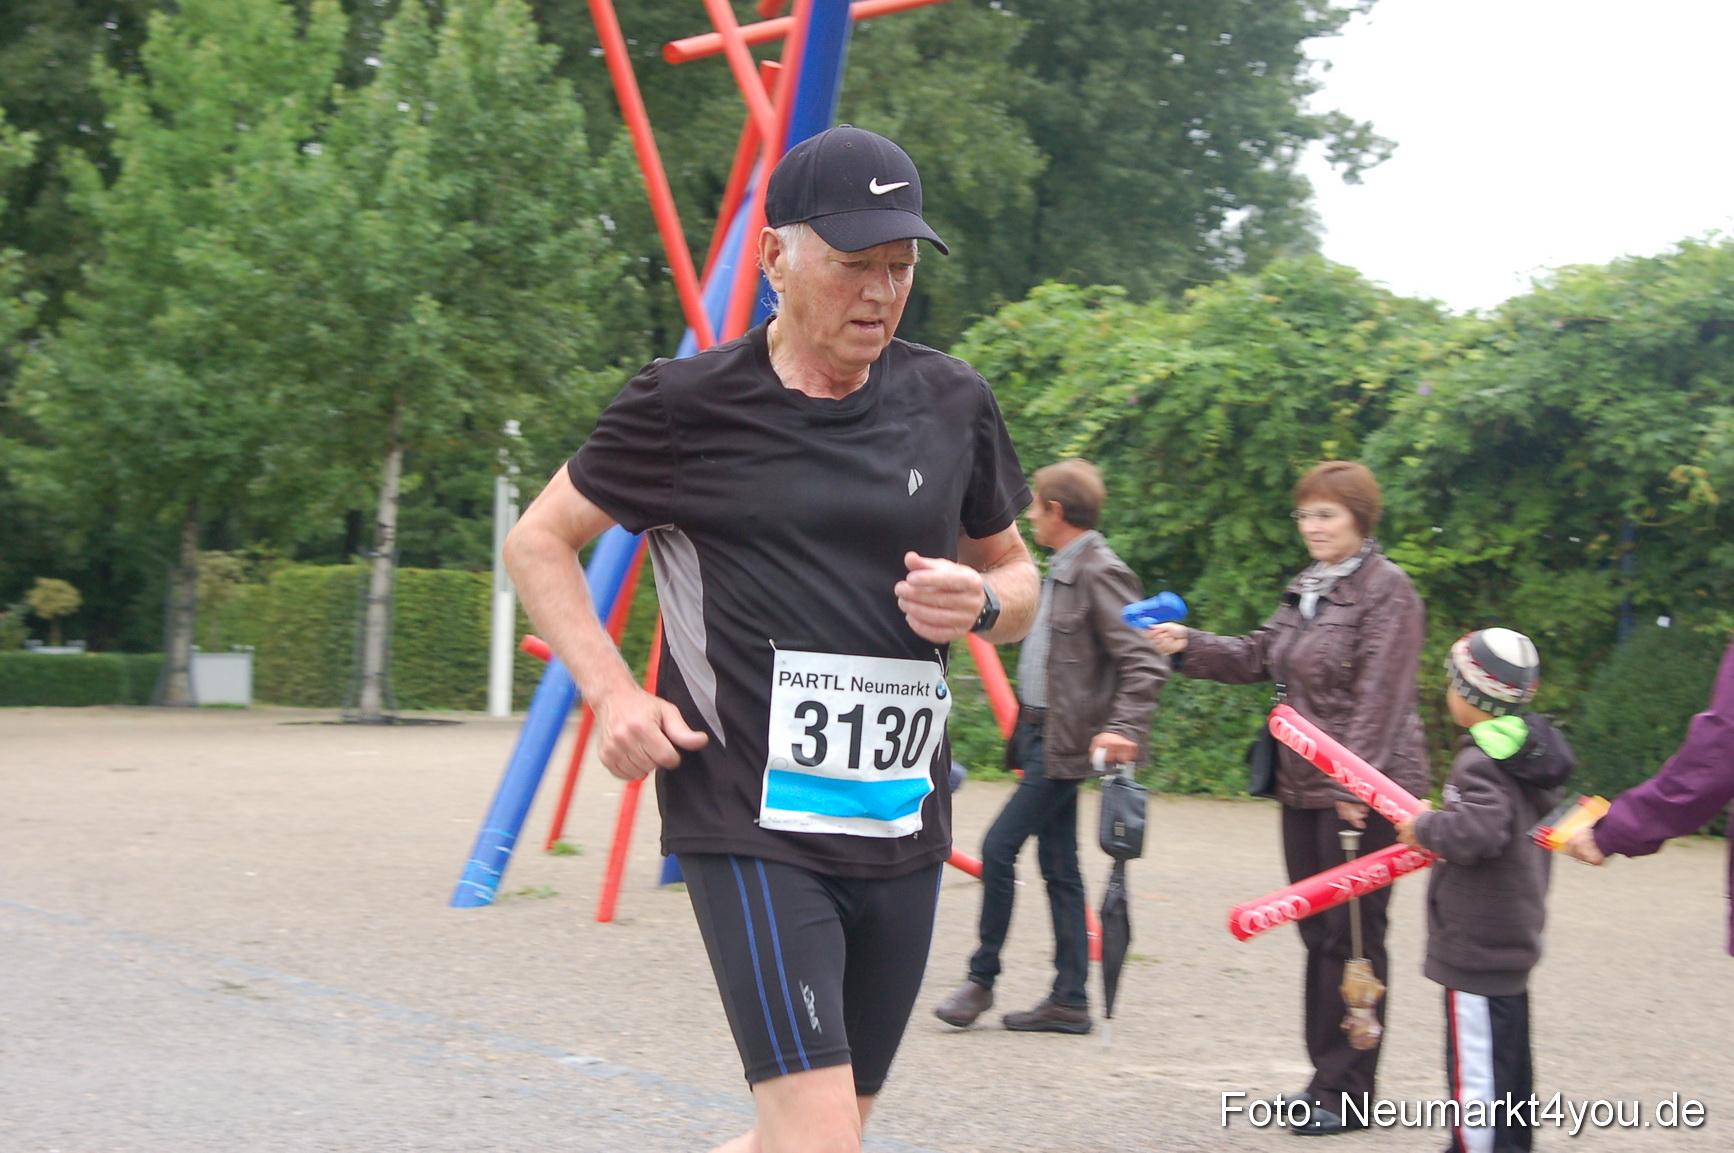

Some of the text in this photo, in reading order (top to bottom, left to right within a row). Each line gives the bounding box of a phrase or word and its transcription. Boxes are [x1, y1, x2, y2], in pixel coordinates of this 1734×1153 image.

[778, 671, 931, 697] PARTL Neumarkt
[791, 700, 933, 771] 3130
